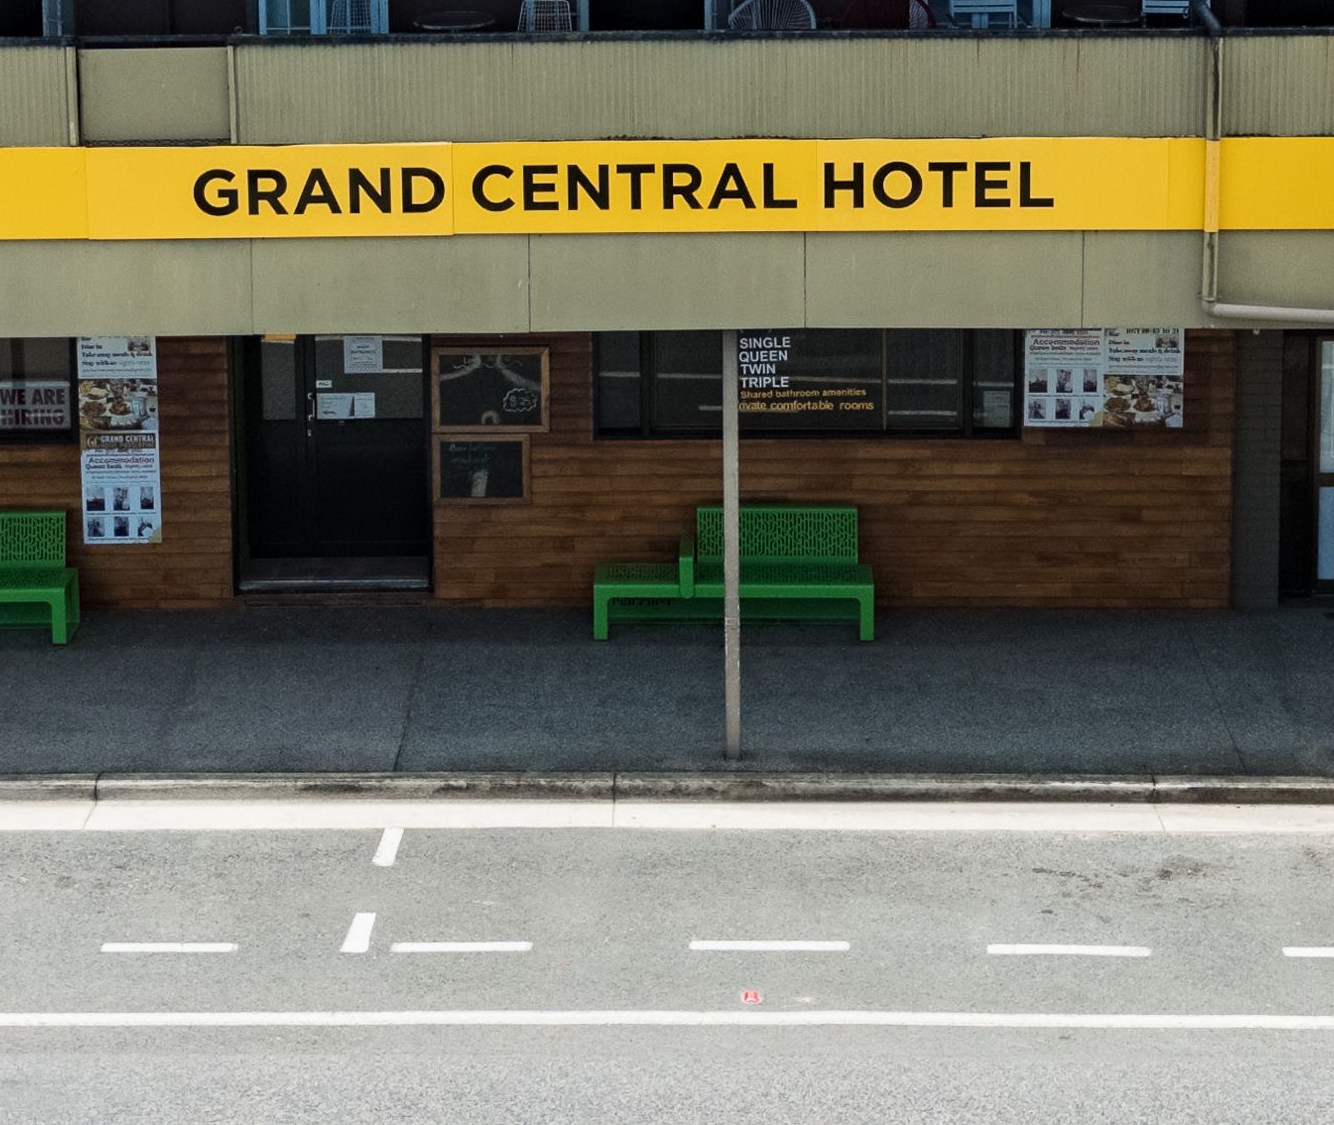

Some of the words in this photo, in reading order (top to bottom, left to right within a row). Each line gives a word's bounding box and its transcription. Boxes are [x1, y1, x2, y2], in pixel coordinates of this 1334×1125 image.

[193, 167, 445, 216] GRAND
[471, 162, 798, 212] CENTRAL
[823, 161, 1054, 209] HOTEL
[740, 336, 791, 349] SINGLE
[1032, 338, 1101, 346] Accommodation
[739, 350, 788, 363] QUEEN
[740, 363, 776, 375] TWIN
[741, 376, 789, 388] TRIPLE
[0, 388, 27, 405] WE
[31, 388, 65, 405] ARE
[741, 390, 773, 399] Shared
[776, 388, 820, 398] bathroom
[822, 386, 867, 397] amenities
[770, 400, 834, 411] comfortable
[839, 402, 875, 411] rooms
[1, 408, 66, 426] HIRING
[125, 435, 155, 443] CENTRAL
[88, 457, 155, 465] Accommodation
